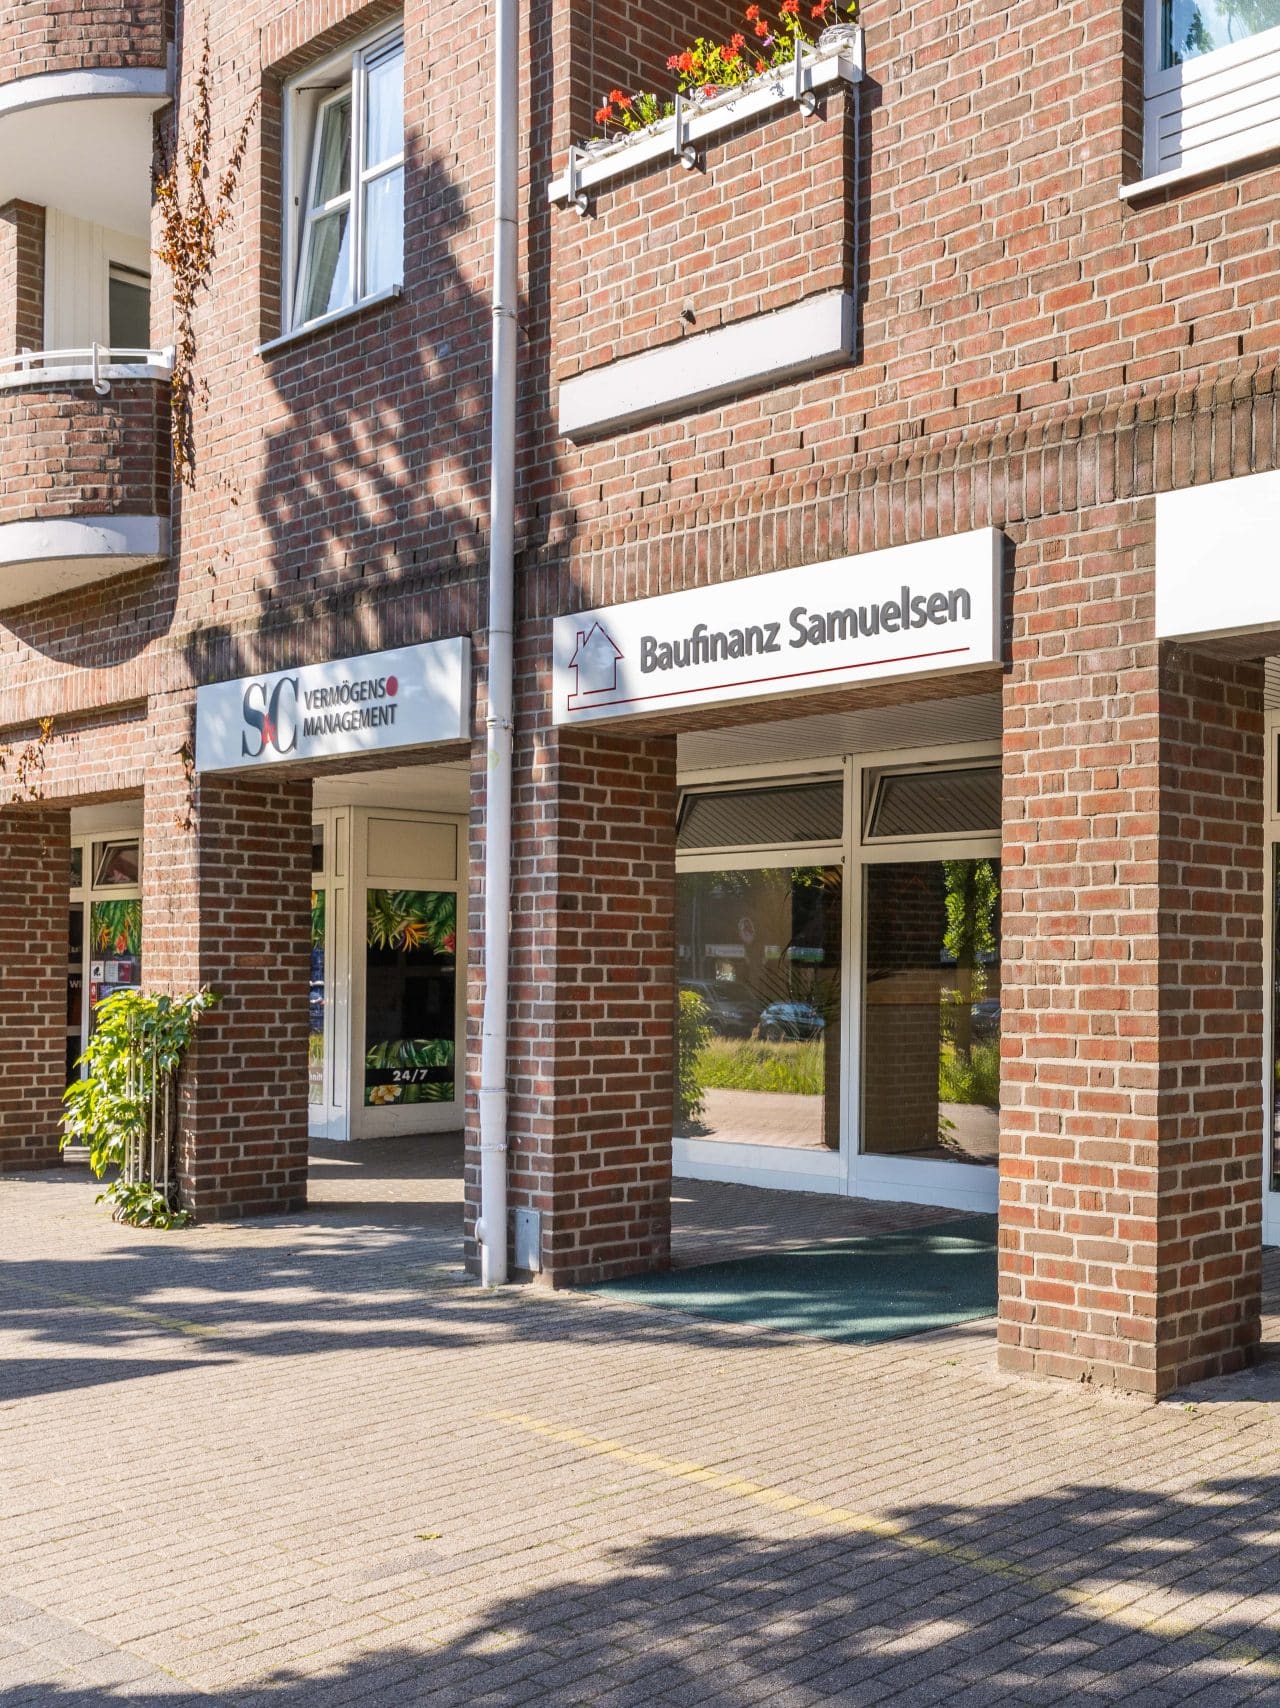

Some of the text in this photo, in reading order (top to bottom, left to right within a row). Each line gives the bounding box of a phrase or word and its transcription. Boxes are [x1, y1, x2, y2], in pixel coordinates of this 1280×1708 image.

[640, 585, 972, 674] Baufinanz Samuelsen
[304, 675, 387, 711] VERMÖGENS
[242, 676, 300, 757] S&C
[303, 703, 398, 737] MANAGEMENT
[392, 1069, 428, 1083] 24/7
